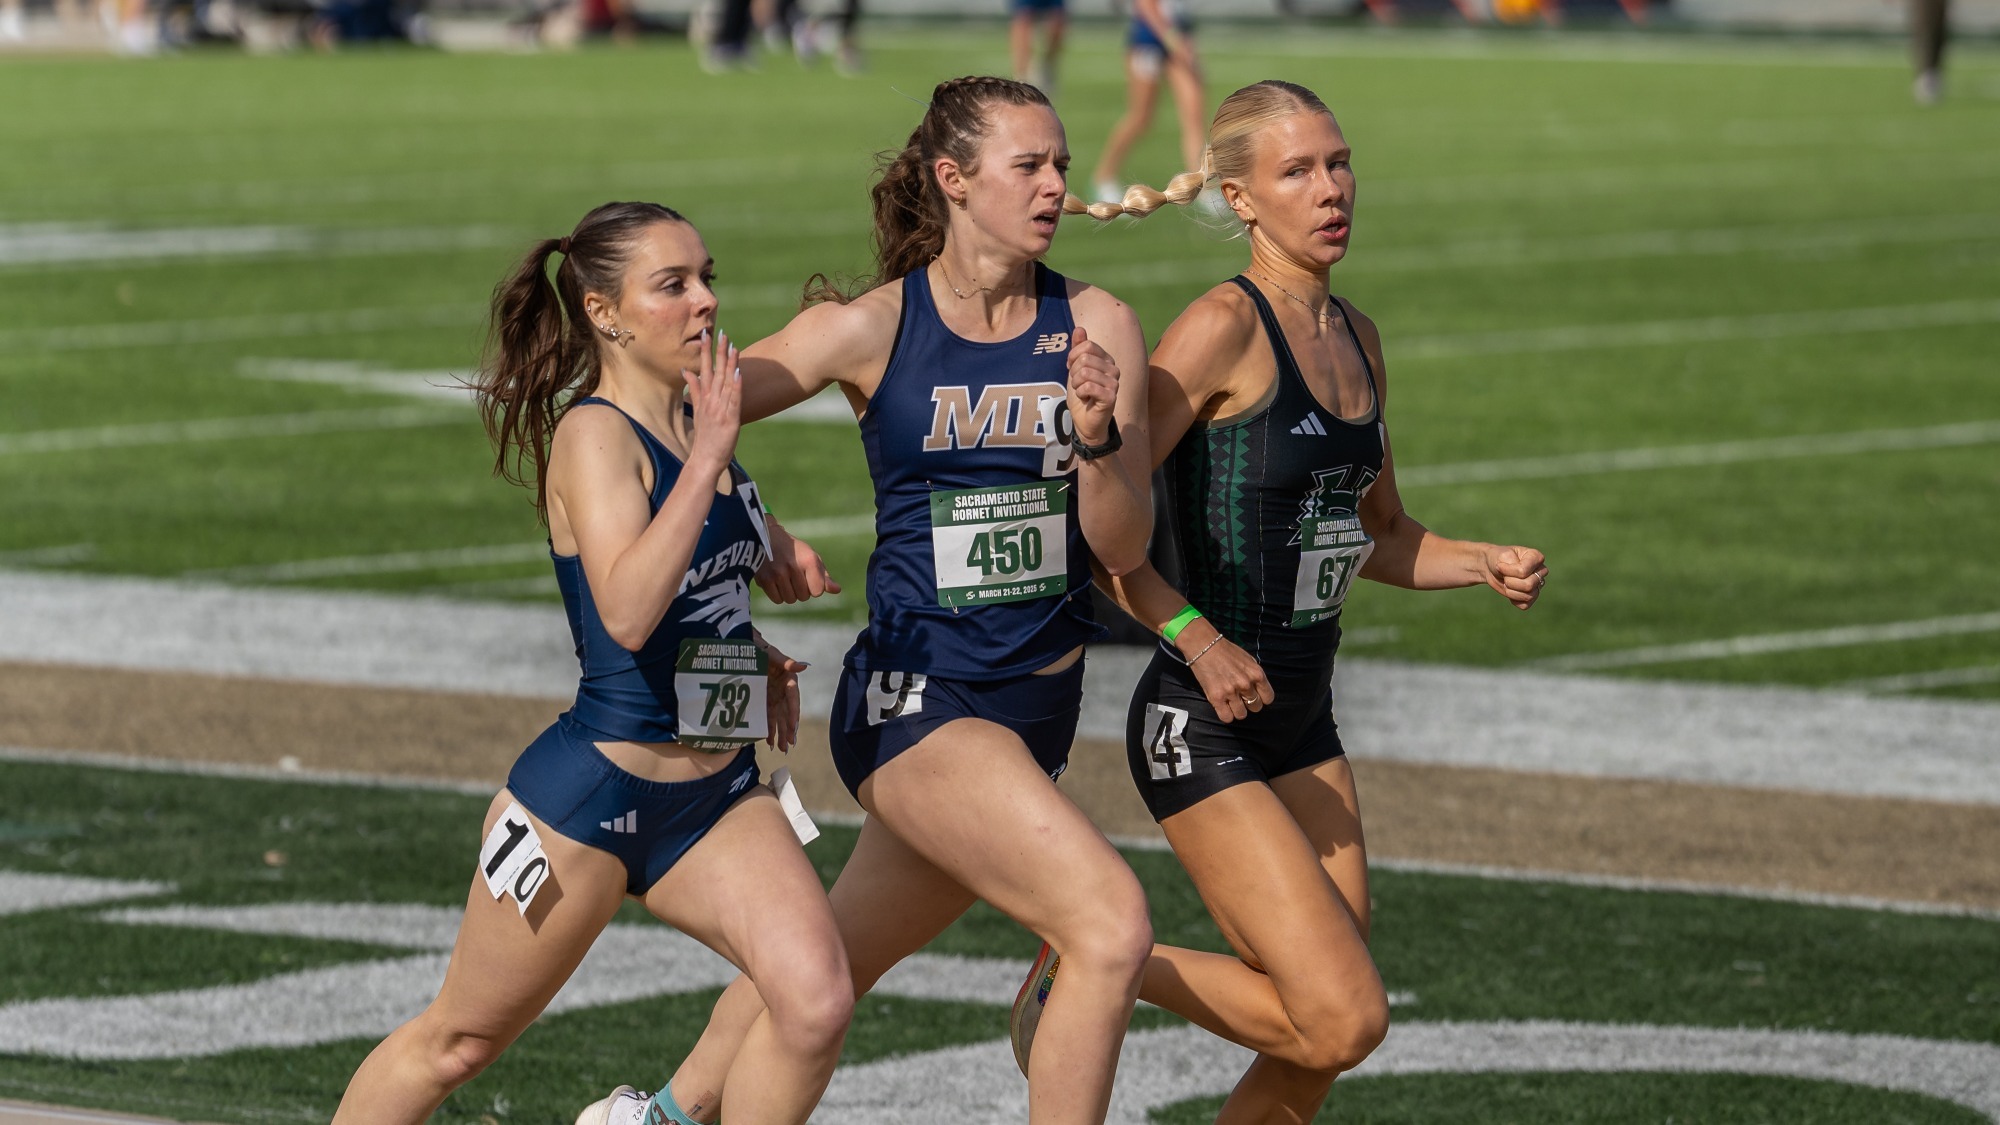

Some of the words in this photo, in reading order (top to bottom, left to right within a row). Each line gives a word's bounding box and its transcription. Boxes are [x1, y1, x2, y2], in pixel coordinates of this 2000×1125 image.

[1033, 332, 1069, 355] NB
[955, 492, 1020, 508] SACRAMENTO
[1022, 487, 1047, 502] STATE
[952, 507, 990, 521] HORNET
[993, 500, 1050, 518] INVITATIONAL
[1316, 518, 1356, 533] SACRAMENTO
[1313, 533, 1338, 547] HORNET
[966, 526, 1043, 576] 450
[978, 589, 1002, 599] MARCH
[1002, 586, 1023, 597] 21-22,
[1023, 584, 1038, 594] 2025
[697, 644, 739, 657] SACRAMENTO
[740, 645, 756, 658] STATE
[691, 657, 721, 670] HORNET
[723, 658, 758, 671] INVITATIONAL
[699, 683, 751, 729] 732
[1150, 711, 1182, 778] 4
